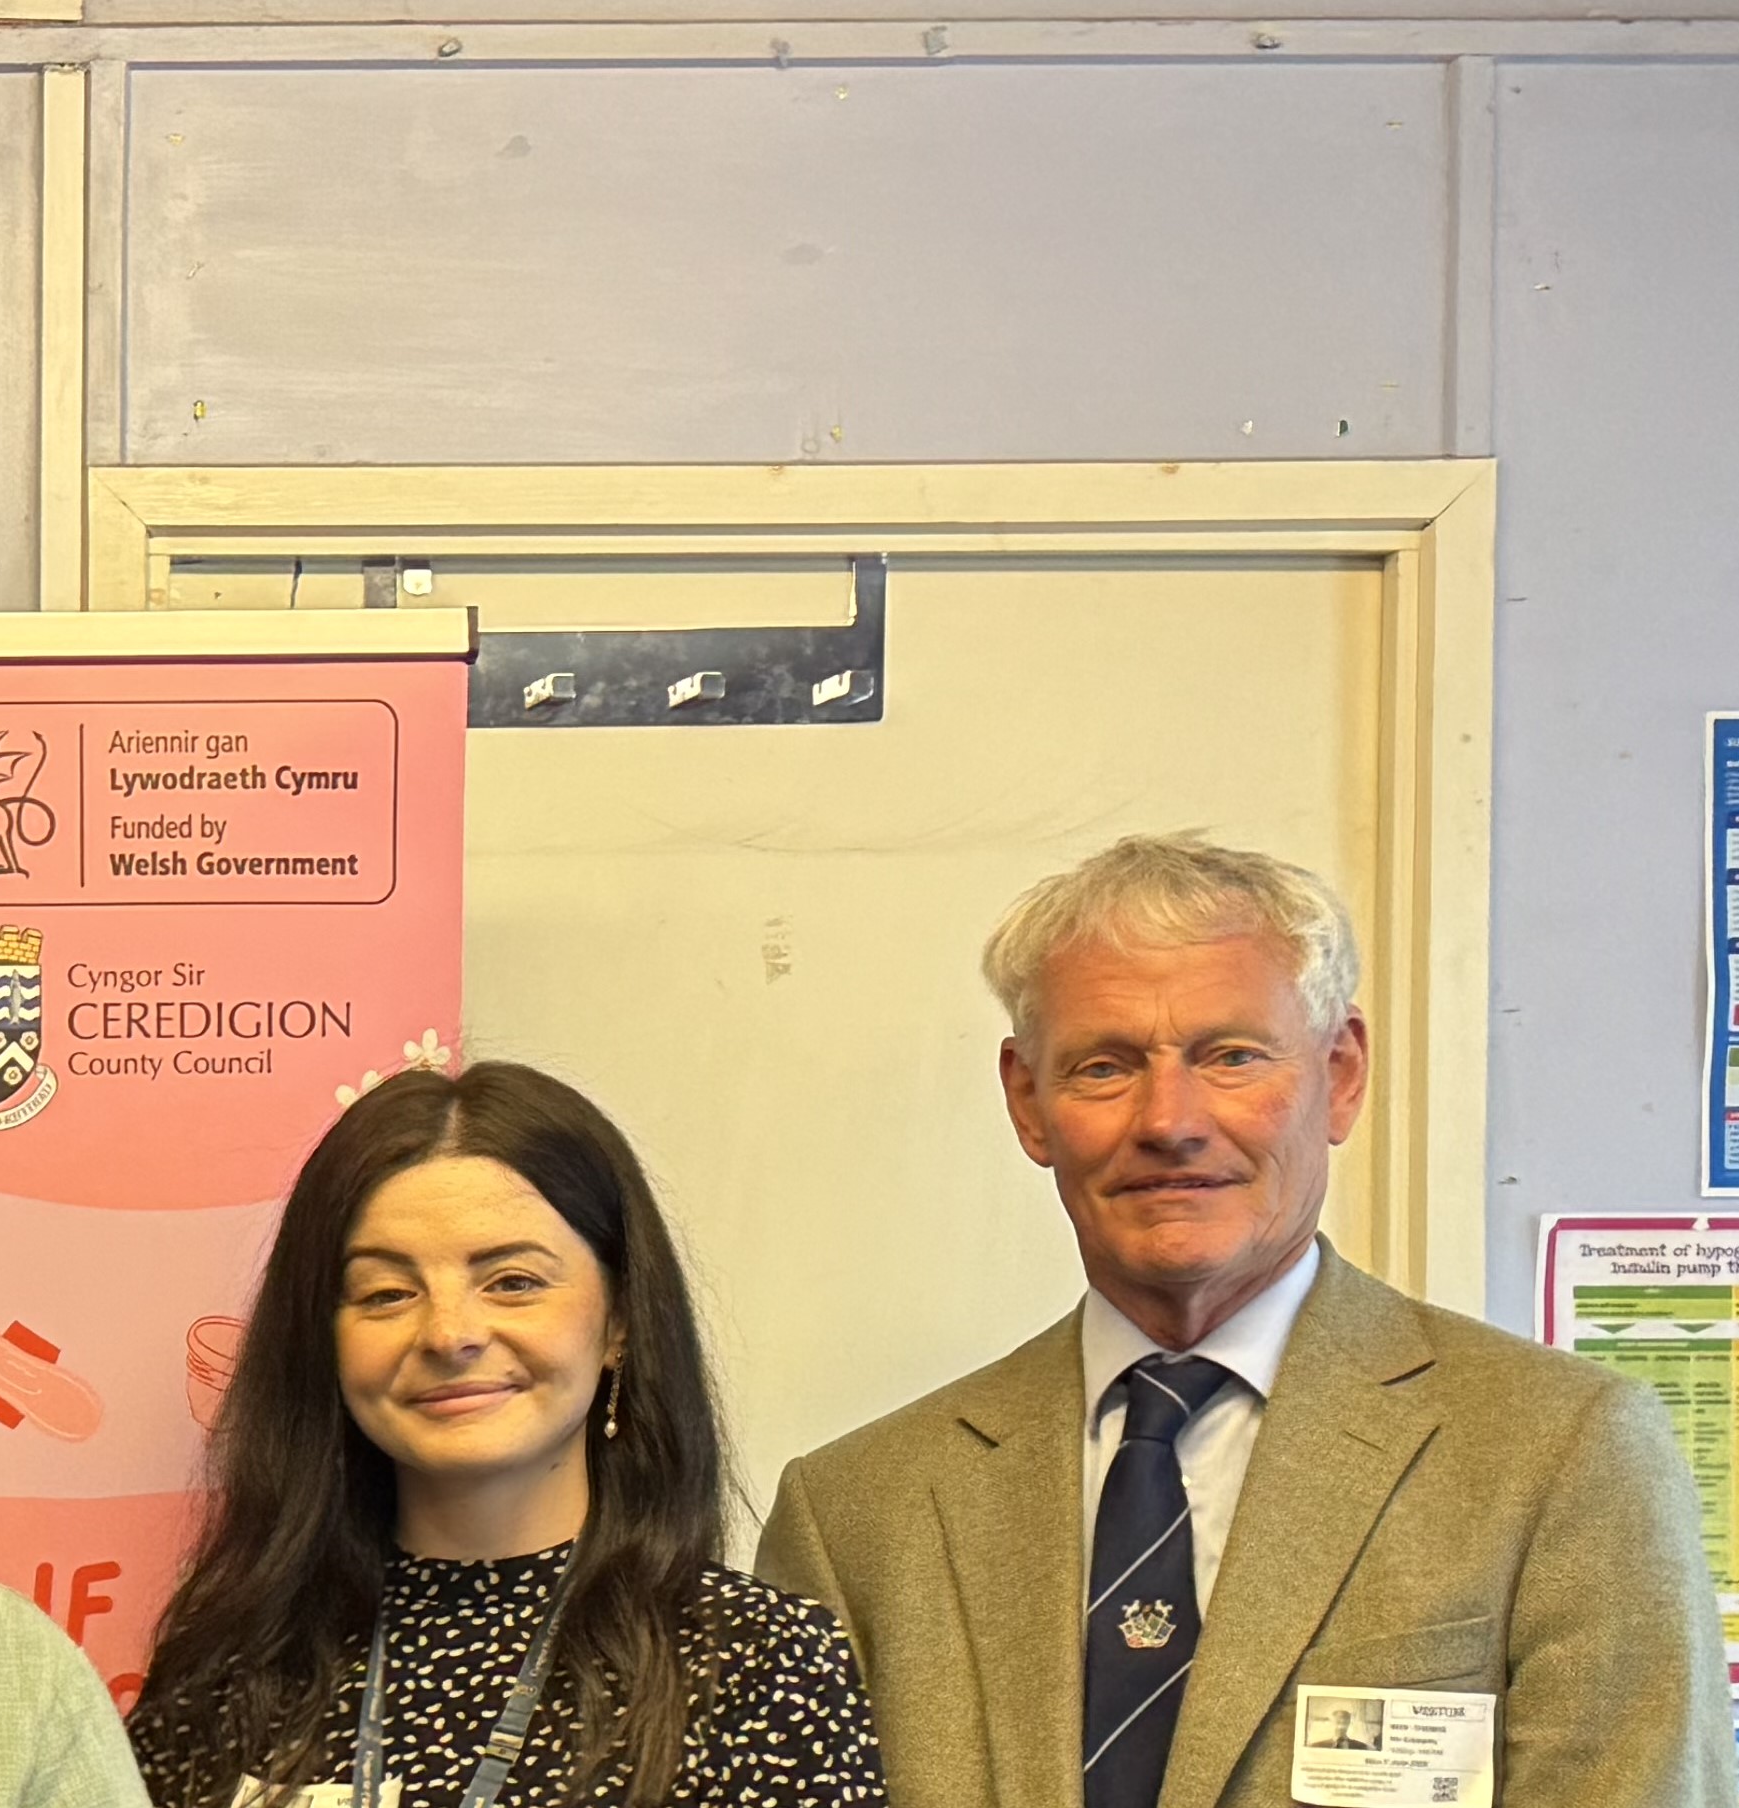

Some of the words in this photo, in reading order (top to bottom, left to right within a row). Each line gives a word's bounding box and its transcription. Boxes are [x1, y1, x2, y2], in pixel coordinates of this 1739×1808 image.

[109, 730, 199, 753] Ariennir
[206, 735, 247, 759] gan
[110, 765, 266, 797] Lywodraeth
[276, 766, 358, 795] Cymru
[111, 814, 192, 839] Funded
[201, 814, 226, 844] by
[110, 851, 187, 876] Welsh
[197, 852, 358, 875] Government
[68, 964, 162, 993] Cyngor
[172, 963, 205, 986] Sir
[68, 1001, 350, 1039] CEREDIGION
[68, 1052, 162, 1080] County
[173, 1049, 271, 1074] Council
[1579, 1244, 1666, 1257] Treatment
[1673, 1244, 1692, 1257] of
[1610, 1262, 1671, 1274] Insulin
[1676, 1263, 1721, 1277] pump
